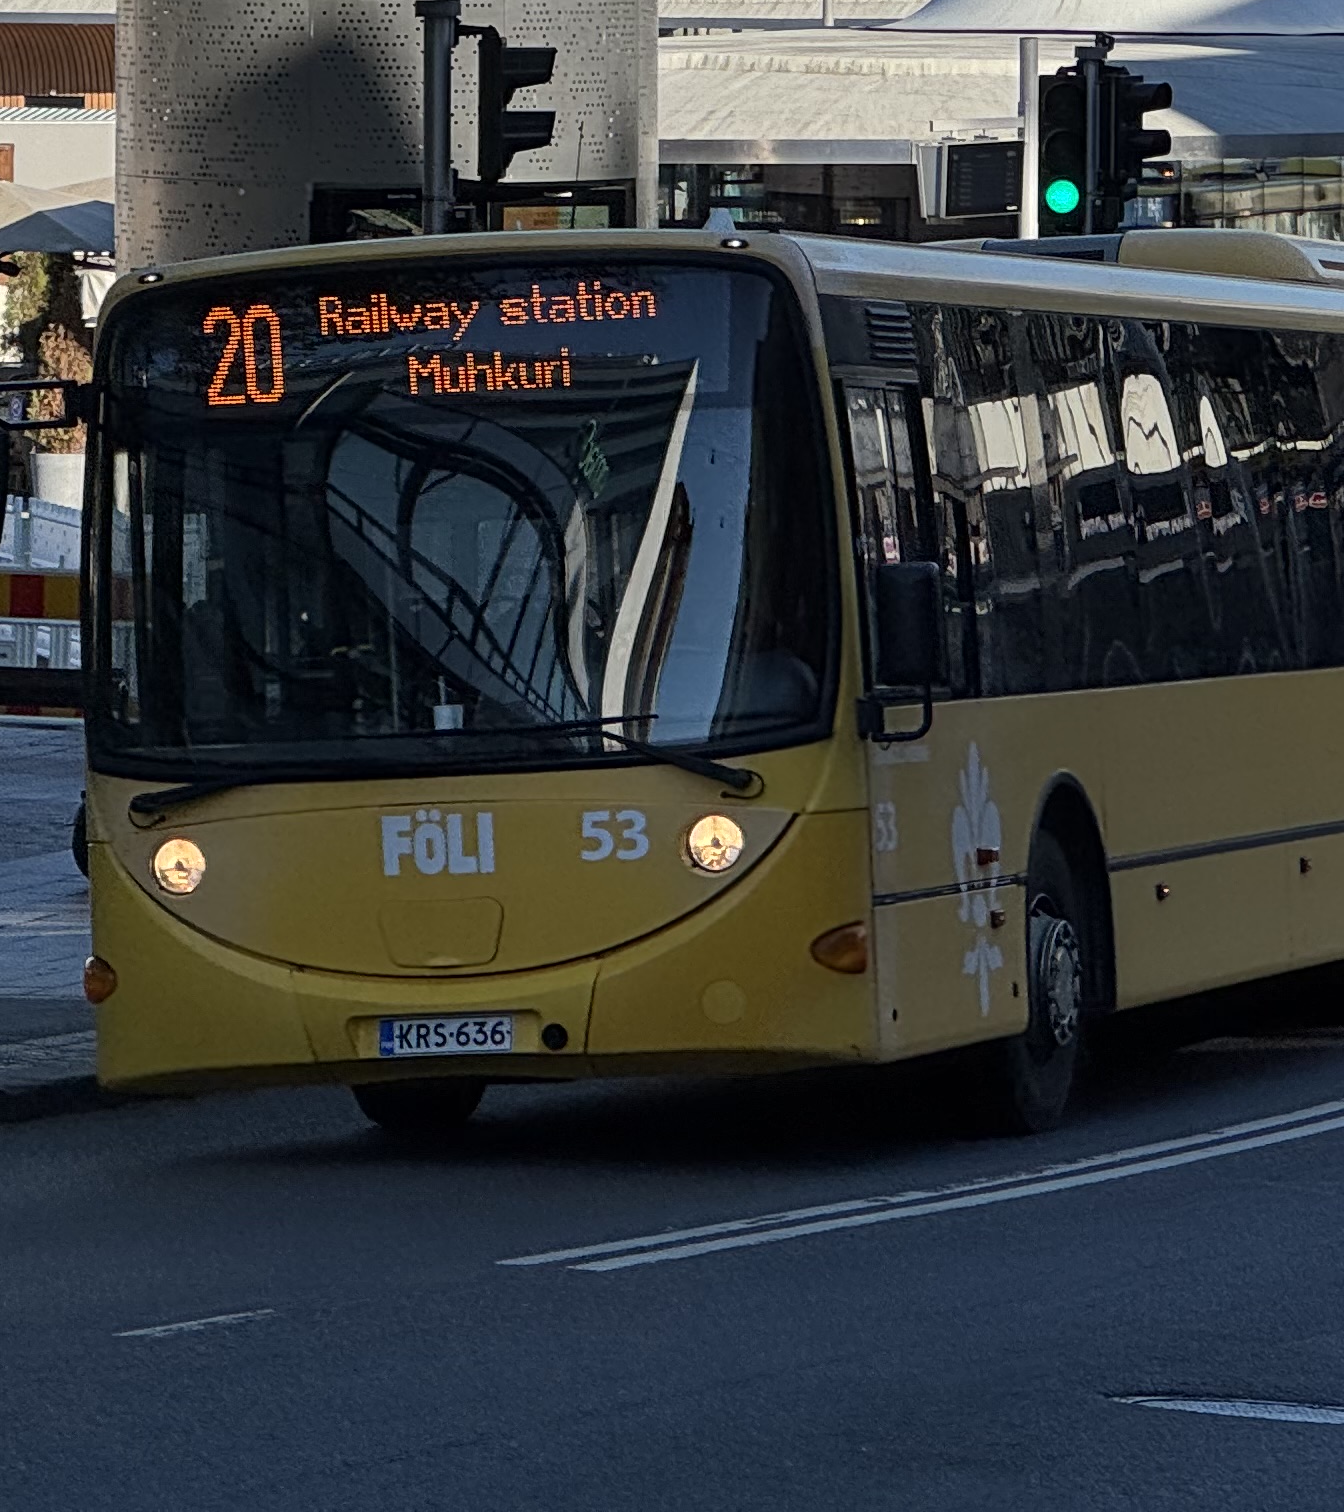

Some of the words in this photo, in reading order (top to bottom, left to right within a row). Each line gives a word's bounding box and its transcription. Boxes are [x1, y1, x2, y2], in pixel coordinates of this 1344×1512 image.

[318, 293, 480, 341] Railway
[500, 280, 656, 327] station
[203, 304, 285, 406] 20
[407, 347, 572, 395] Muhkuri
[381, 809, 495, 876] FÖLI
[580, 809, 650, 861] 53
[876, 801, 897, 851] 53
[398, 1021, 506, 1049] KRS-636
